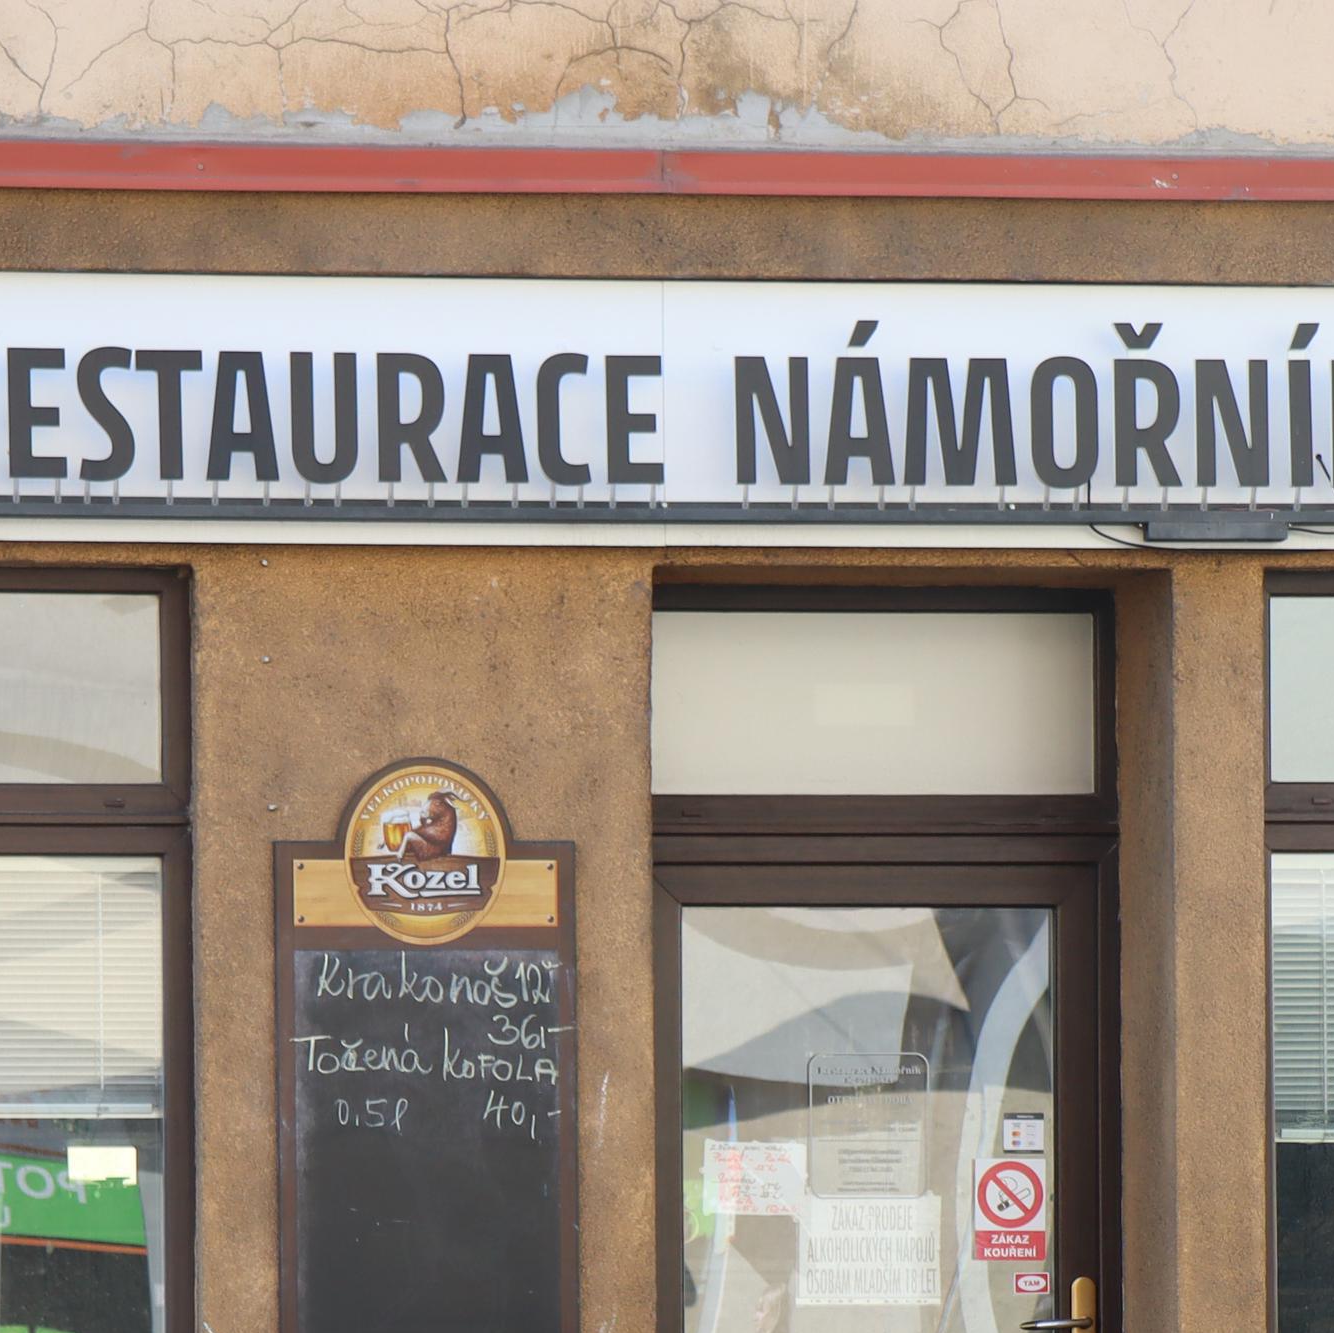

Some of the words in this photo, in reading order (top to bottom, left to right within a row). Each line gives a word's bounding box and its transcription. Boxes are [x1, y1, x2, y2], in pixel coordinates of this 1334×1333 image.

[367, 862, 481, 899] Kozel
[410, 902, 444, 912] 1874
[289, 1022, 434, 1075] Točená
[990, 1232, 1030, 1244] ZÁKAZ
[983, 1245, 1036, 1257] KOUŘENÍ
